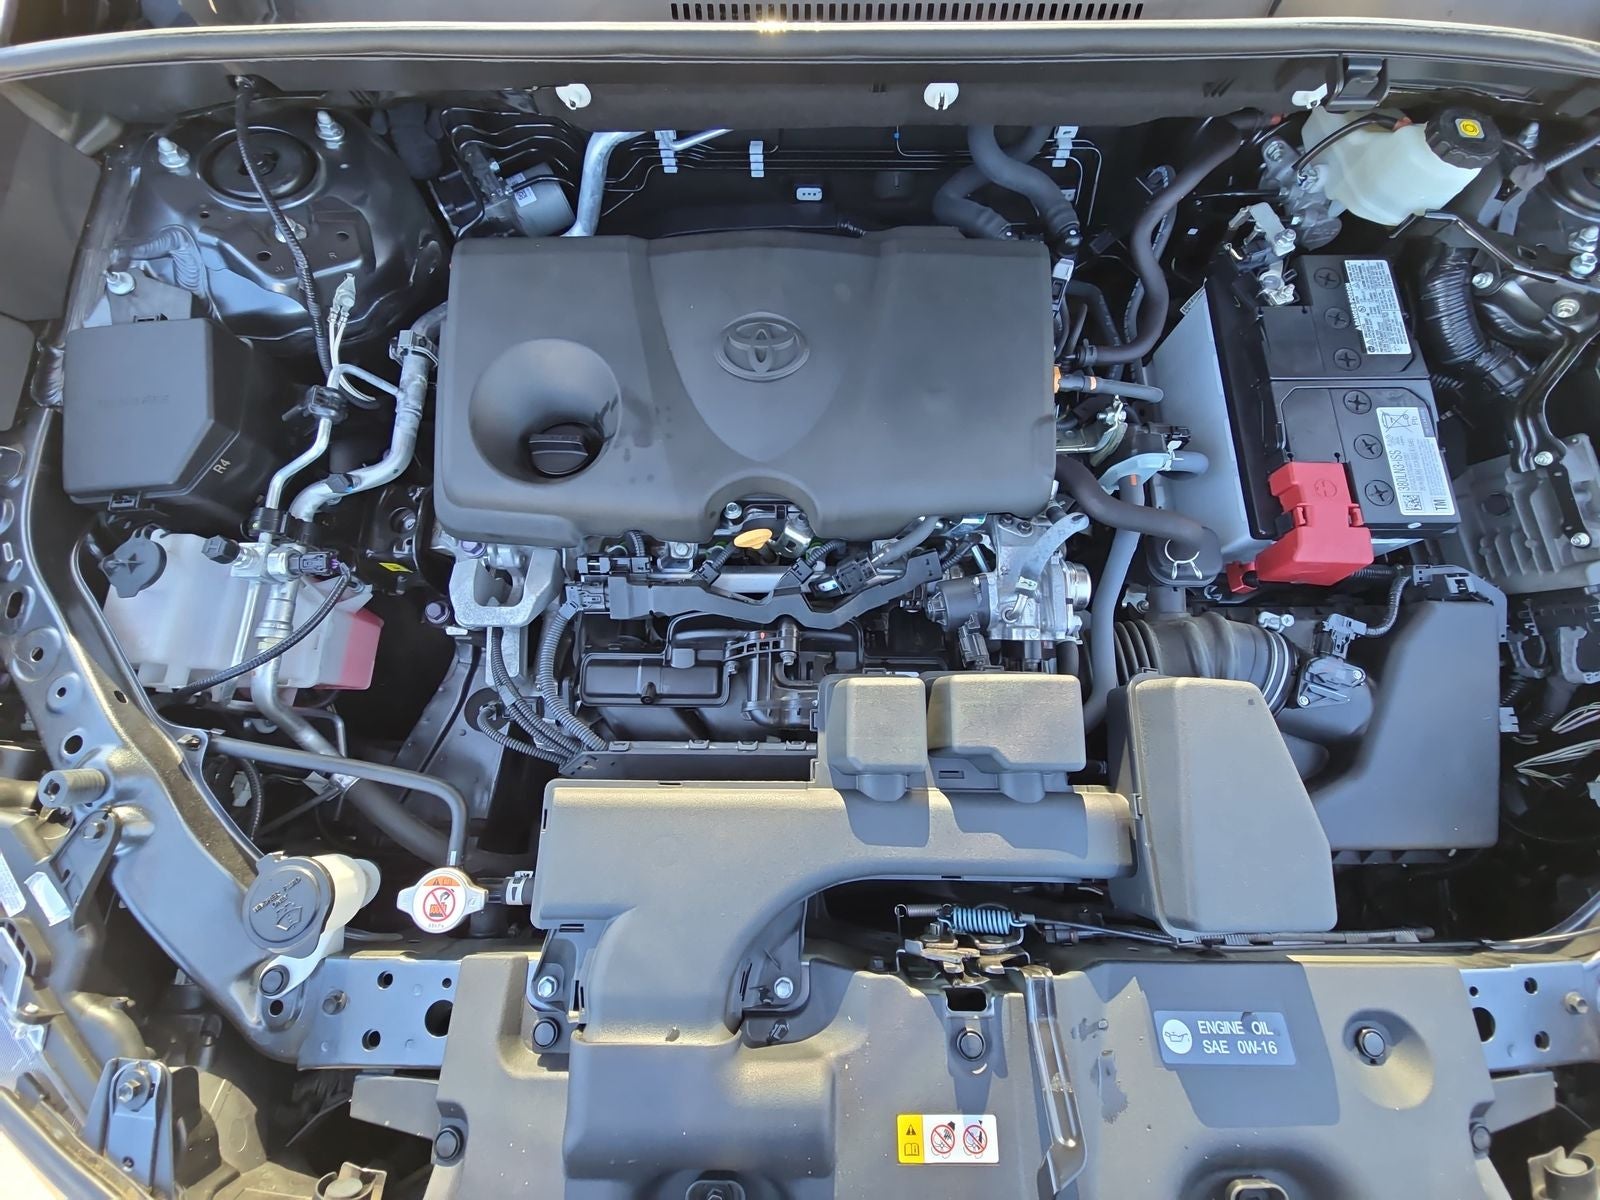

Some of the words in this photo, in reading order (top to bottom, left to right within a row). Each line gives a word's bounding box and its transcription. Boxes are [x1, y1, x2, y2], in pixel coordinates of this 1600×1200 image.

[212, 458, 231, 474] R4
[1389, 449, 1410, 491] 380LN3-ISS
[1433, 499, 1448, 511] TM
[1197, 1020, 1245, 1035] ENGINE
[1251, 1021, 1274, 1035] OIL
[1202, 1040, 1230, 1054] SAE
[1237, 1040, 1278, 1055] 0W-16
